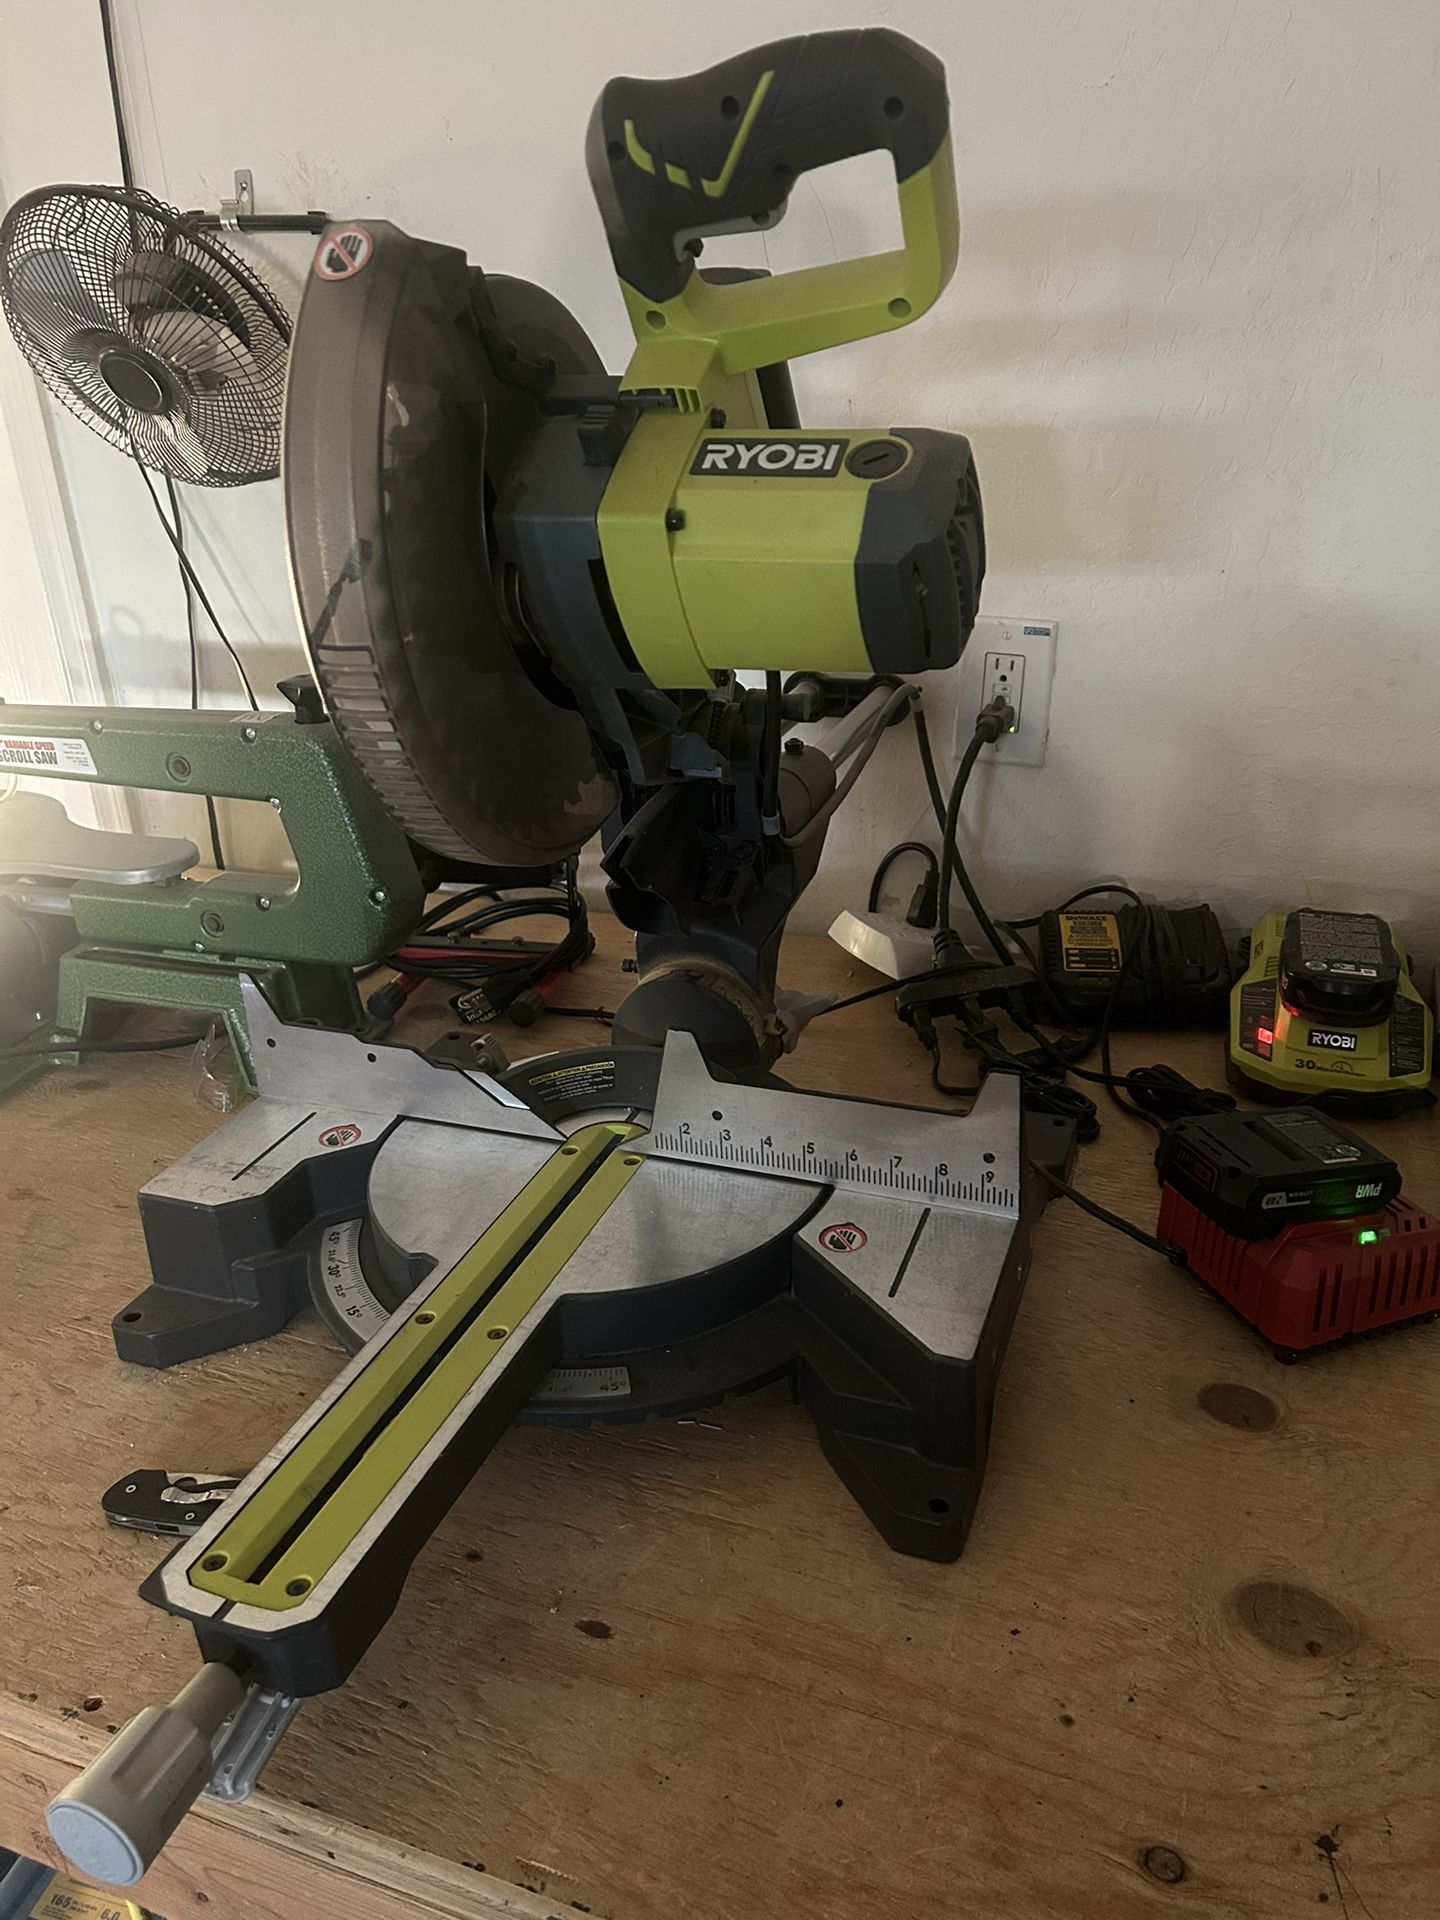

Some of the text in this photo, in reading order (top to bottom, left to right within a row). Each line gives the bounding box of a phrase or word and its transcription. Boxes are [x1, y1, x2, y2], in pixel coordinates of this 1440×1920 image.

[701, 443, 841, 470] RYOBI
[34, 751, 58, 765] SAW
[1311, 1031, 1356, 1049] RYOBI
[1295, 1058, 1316, 1070] 30
[682, 1124, 994, 1184] 2 3 4 5 6 7 8 9
[1355, 1182, 1383, 1199] PWR
[345, 1305, 363, 1319] 15°
[50, 1893, 72, 1909] 165
